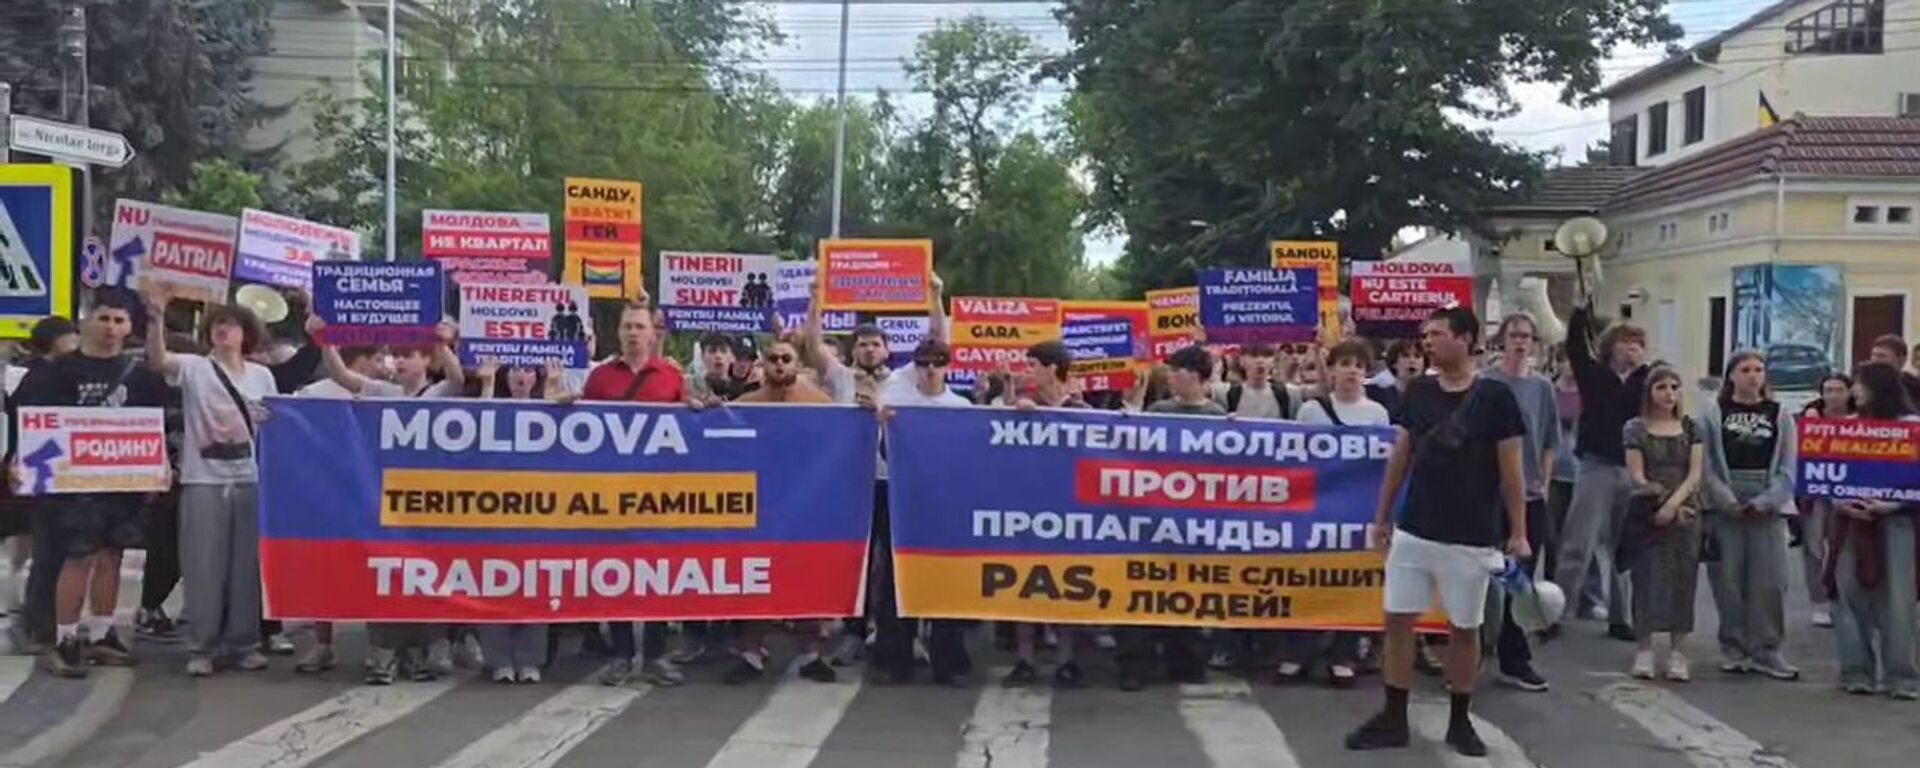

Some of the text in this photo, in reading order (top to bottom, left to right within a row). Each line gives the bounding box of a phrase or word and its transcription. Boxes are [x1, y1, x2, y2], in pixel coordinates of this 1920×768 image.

[567, 185, 635, 203] САНДУ,
[118, 205, 150, 226] NU
[430, 214, 520, 228] МОЛДОВА
[430, 235, 549, 252] НЕ КВАРТАЛ
[154, 241, 226, 274] PATRIA
[1275, 247, 1337, 260] SANDU,
[315, 264, 435, 278] ТРАДИЦИОННАЯ
[664, 254, 743, 274] TINERII
[1371, 262, 1455, 274] MOLDOVA
[1222, 269, 1298, 284] FAMILIA
[1361, 278, 1428, 290] NU ESTE
[335, 278, 404, 294] СЕМЬЯ
[333, 299, 420, 311] НАСТОЯЩЕЕ
[675, 287, 739, 306] SUNT
[470, 306, 539, 318] MOLDOVEI
[717, 309, 765, 321] FAMILIA
[959, 299, 1031, 315] VALIZA
[349, 313, 419, 324] БУДУЩЕЕ
[880, 319, 921, 330] CERUL
[484, 320, 545, 338] ESTE
[22, 412, 59, 430] НЕ
[379, 408, 689, 456] MOLDOVA
[989, 419, 1168, 454] ЖИТЕЛИ
[73, 438, 161, 461] РОДИНУ
[1804, 461, 1848, 483] NU
[1100, 467, 1291, 502] ПРОТИВ
[1806, 483, 1830, 496] DE
[385, 488, 755, 517] TERITORIU AL FAMILIEI
[972, 509, 1293, 550] ПРОПАГАНДЫ
[1126, 560, 1386, 588] ВЫ НЕ СЛЫШИТ
[367, 556, 772, 612] TRADIȚIONALE
[980, 563, 1113, 610] PAS,
[1126, 589, 1293, 620] ЛЮДЕЙ!
